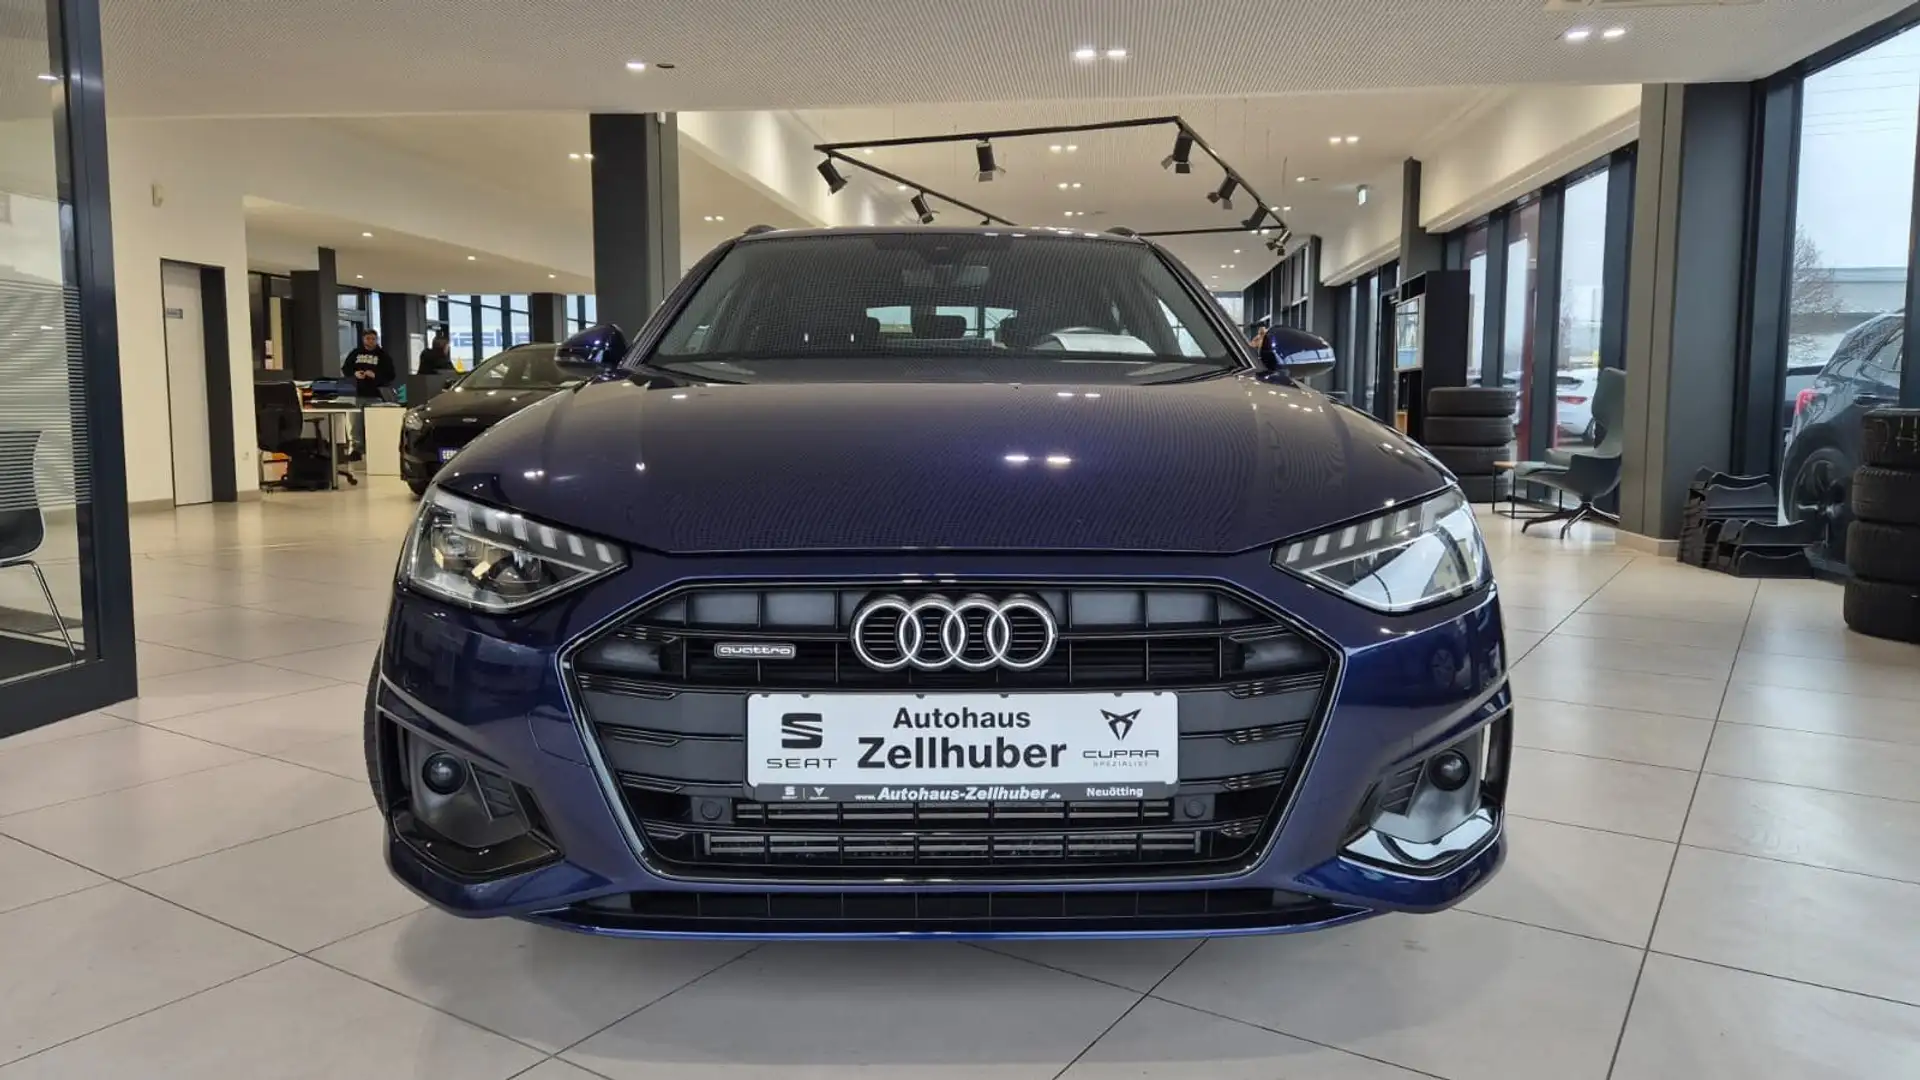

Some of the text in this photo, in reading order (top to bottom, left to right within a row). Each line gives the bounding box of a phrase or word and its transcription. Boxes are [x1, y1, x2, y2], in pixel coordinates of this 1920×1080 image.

[720, 646, 791, 656] quattro
[893, 707, 1031, 729] Autohaus
[857, 736, 1067, 769] Zellhuber
[1083, 749, 1160, 759] CUPRA
[766, 758, 838, 769] SEAT
[1086, 786, 1144, 798] Neuötting
